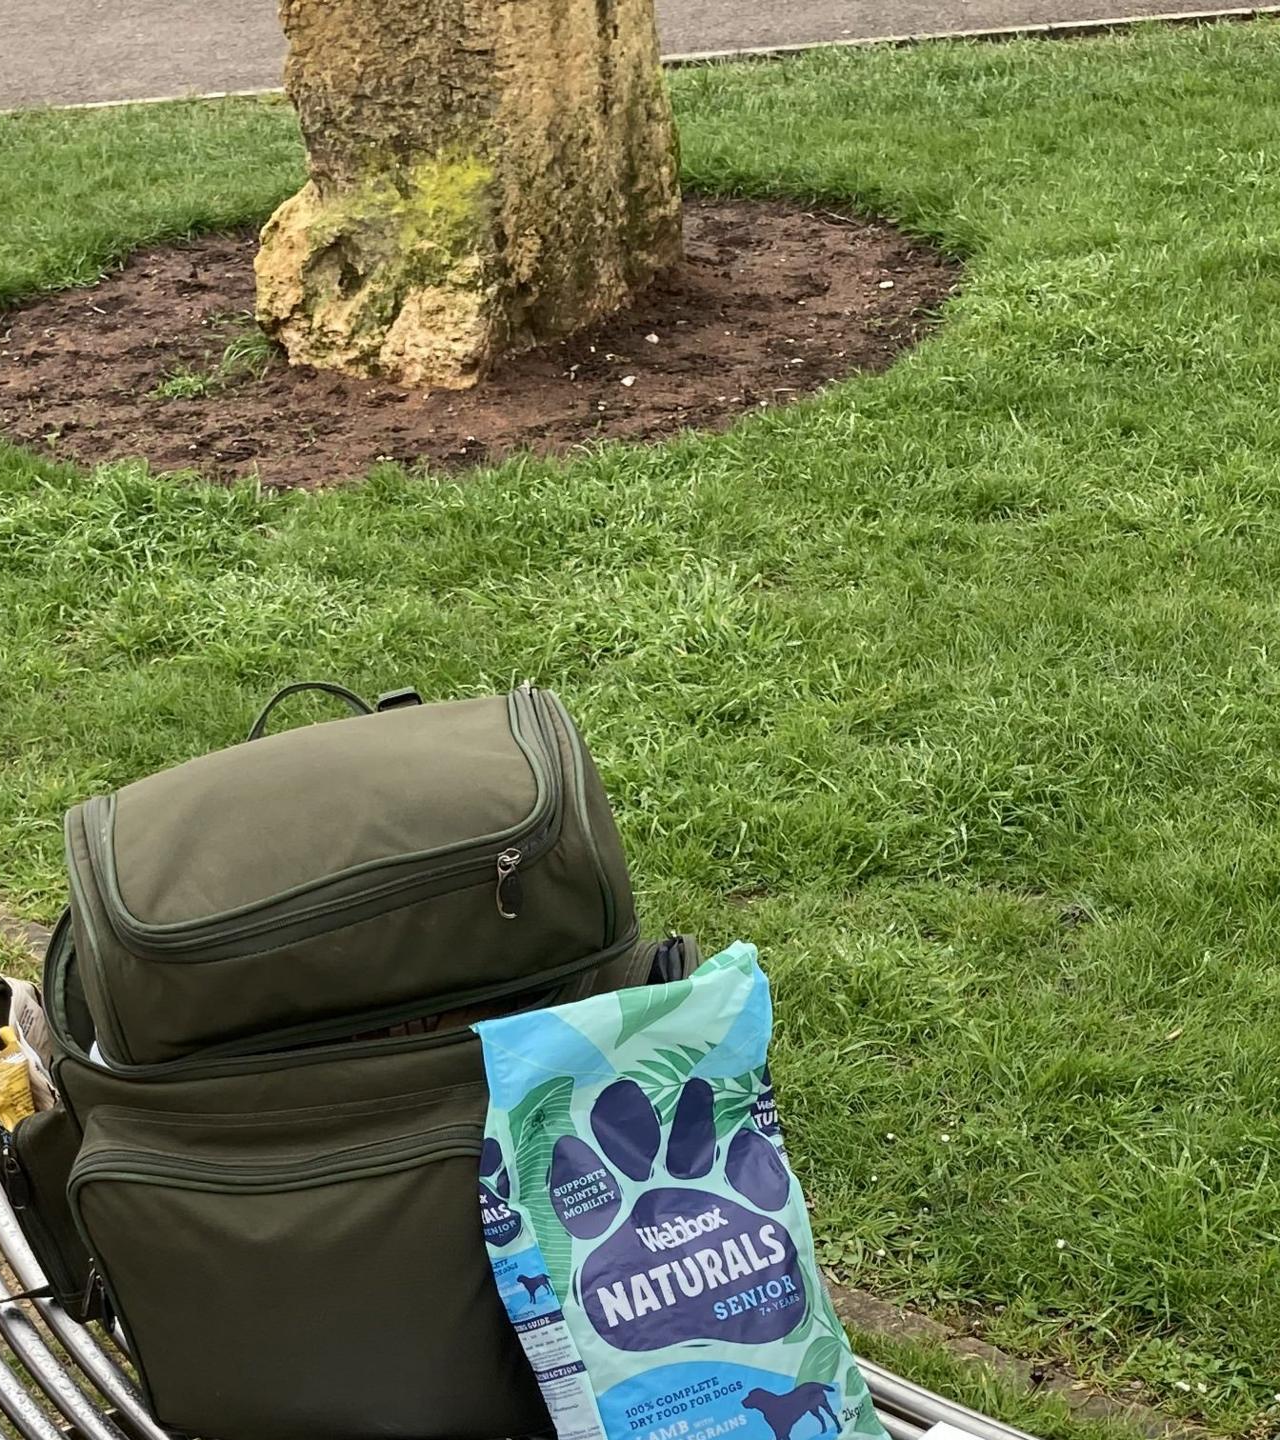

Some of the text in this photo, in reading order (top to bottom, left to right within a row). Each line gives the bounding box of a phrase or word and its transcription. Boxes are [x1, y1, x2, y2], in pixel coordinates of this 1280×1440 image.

[553, 1168, 607, 1198] SUPPORTS
[562, 1182, 608, 1208] JOINTS &
[563, 1190, 616, 1220] MOBILITY
[635, 1207, 728, 1253] Webbox
[596, 1224, 787, 1329] NATURALS
[713, 1274, 796, 1321] SENIOR
[759, 1293, 800, 1317] 7+ YEARS
[624, 1376, 720, 1419] 100% COMPLETE
[629, 1380, 744, 1430] DRY FOOD FOR DOGS
